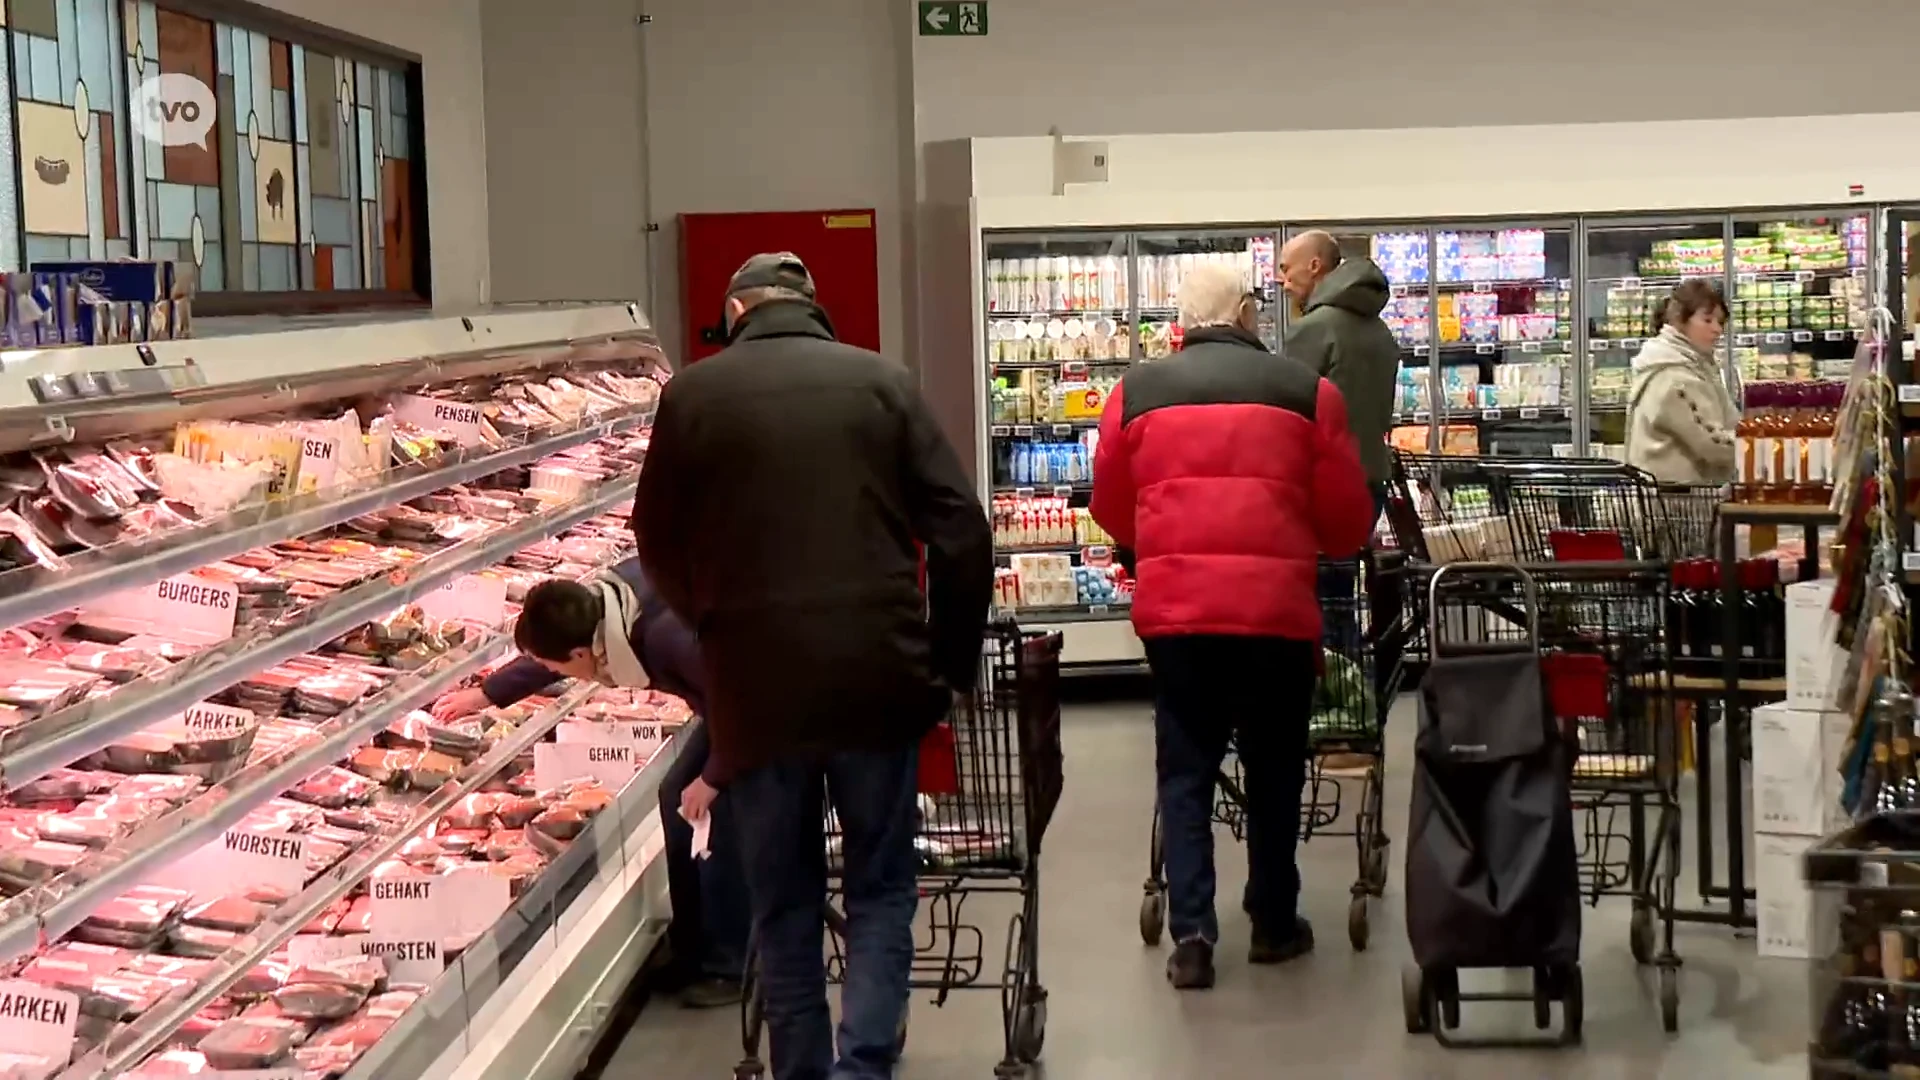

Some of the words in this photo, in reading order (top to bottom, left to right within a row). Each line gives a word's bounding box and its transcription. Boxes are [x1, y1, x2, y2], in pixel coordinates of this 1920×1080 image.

[435, 405, 479, 424] PENSEN
[303, 439, 332, 459] SEN
[158, 580, 230, 609] BURGERS
[632, 726, 656, 739] WOK
[589, 747, 629, 761] GEHAKT
[225, 831, 301, 859] WORSTEN
[375, 882, 430, 899] GEHAKT
[0, 993, 67, 1025] ARKEN
